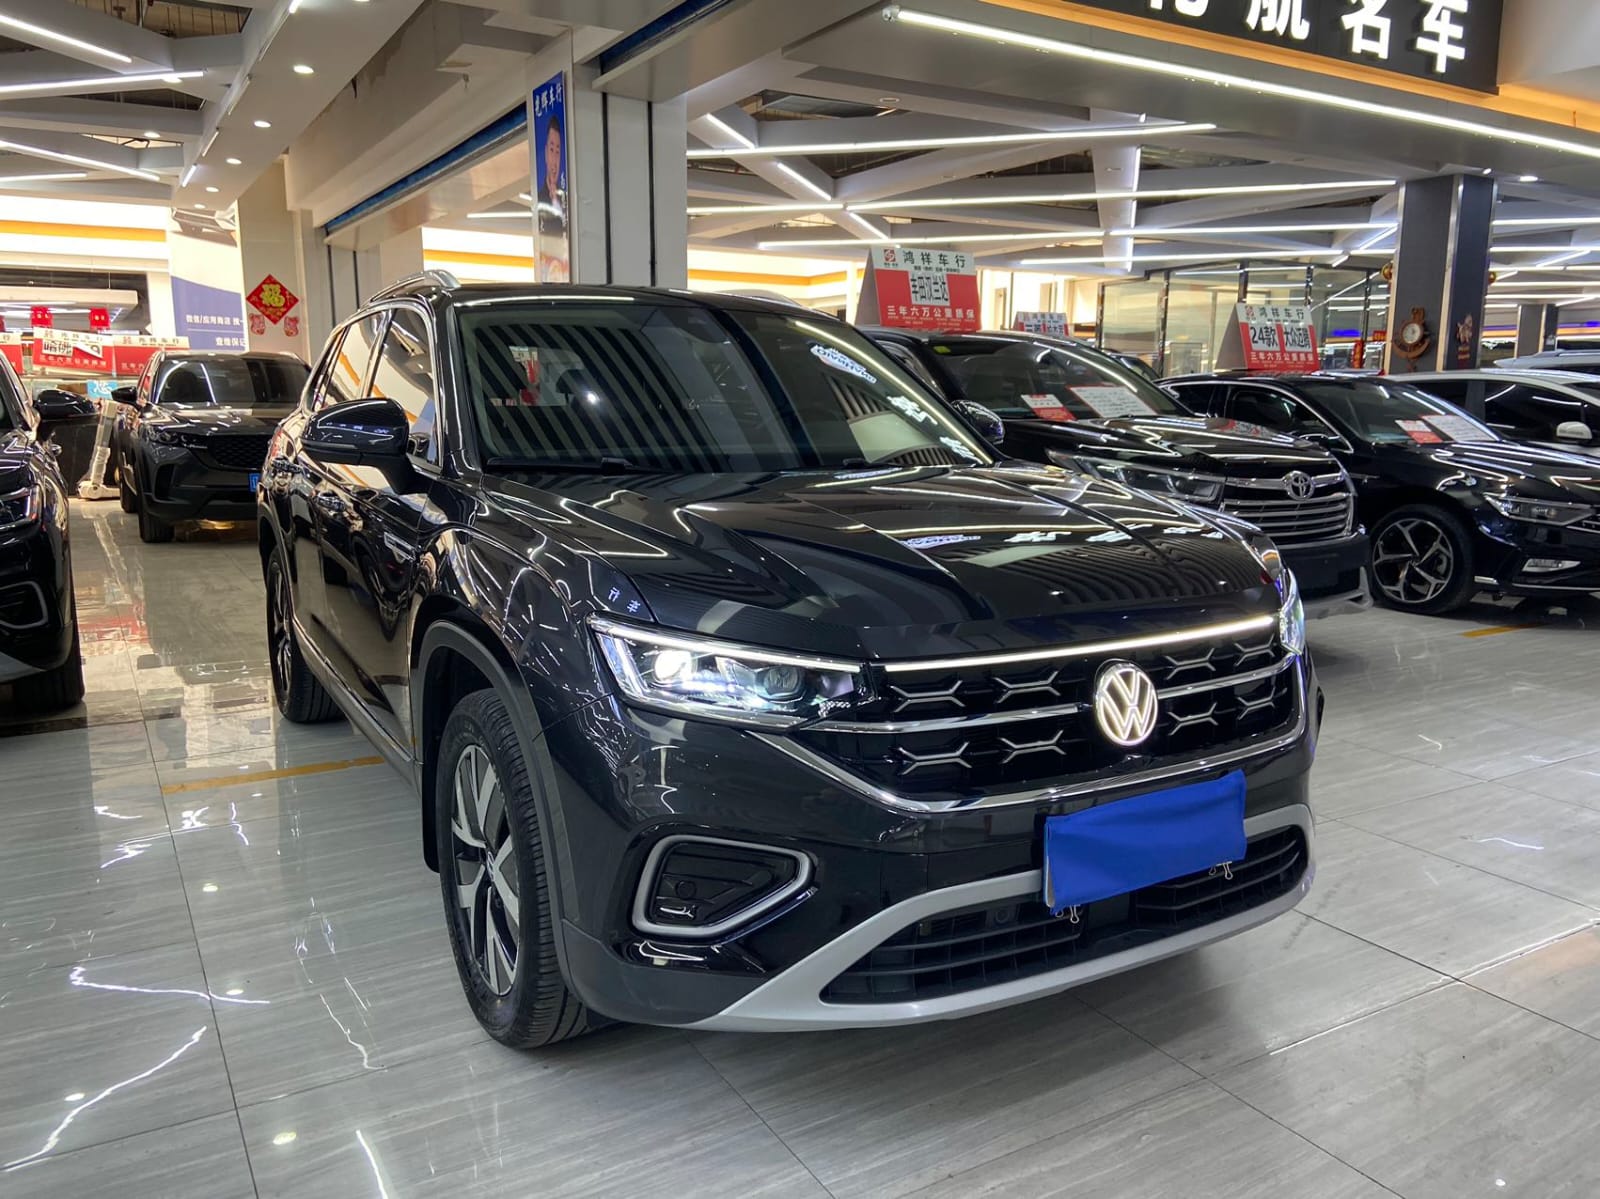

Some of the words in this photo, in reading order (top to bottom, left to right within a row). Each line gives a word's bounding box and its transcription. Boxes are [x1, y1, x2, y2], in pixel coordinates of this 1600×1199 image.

[1146, 0, 1468, 73] 航名车
[902, 250, 966, 268] 鸿祥车行
[887, 305, 975, 318] 三年六万公里质保
[1250, 326, 1278, 347] 24款
